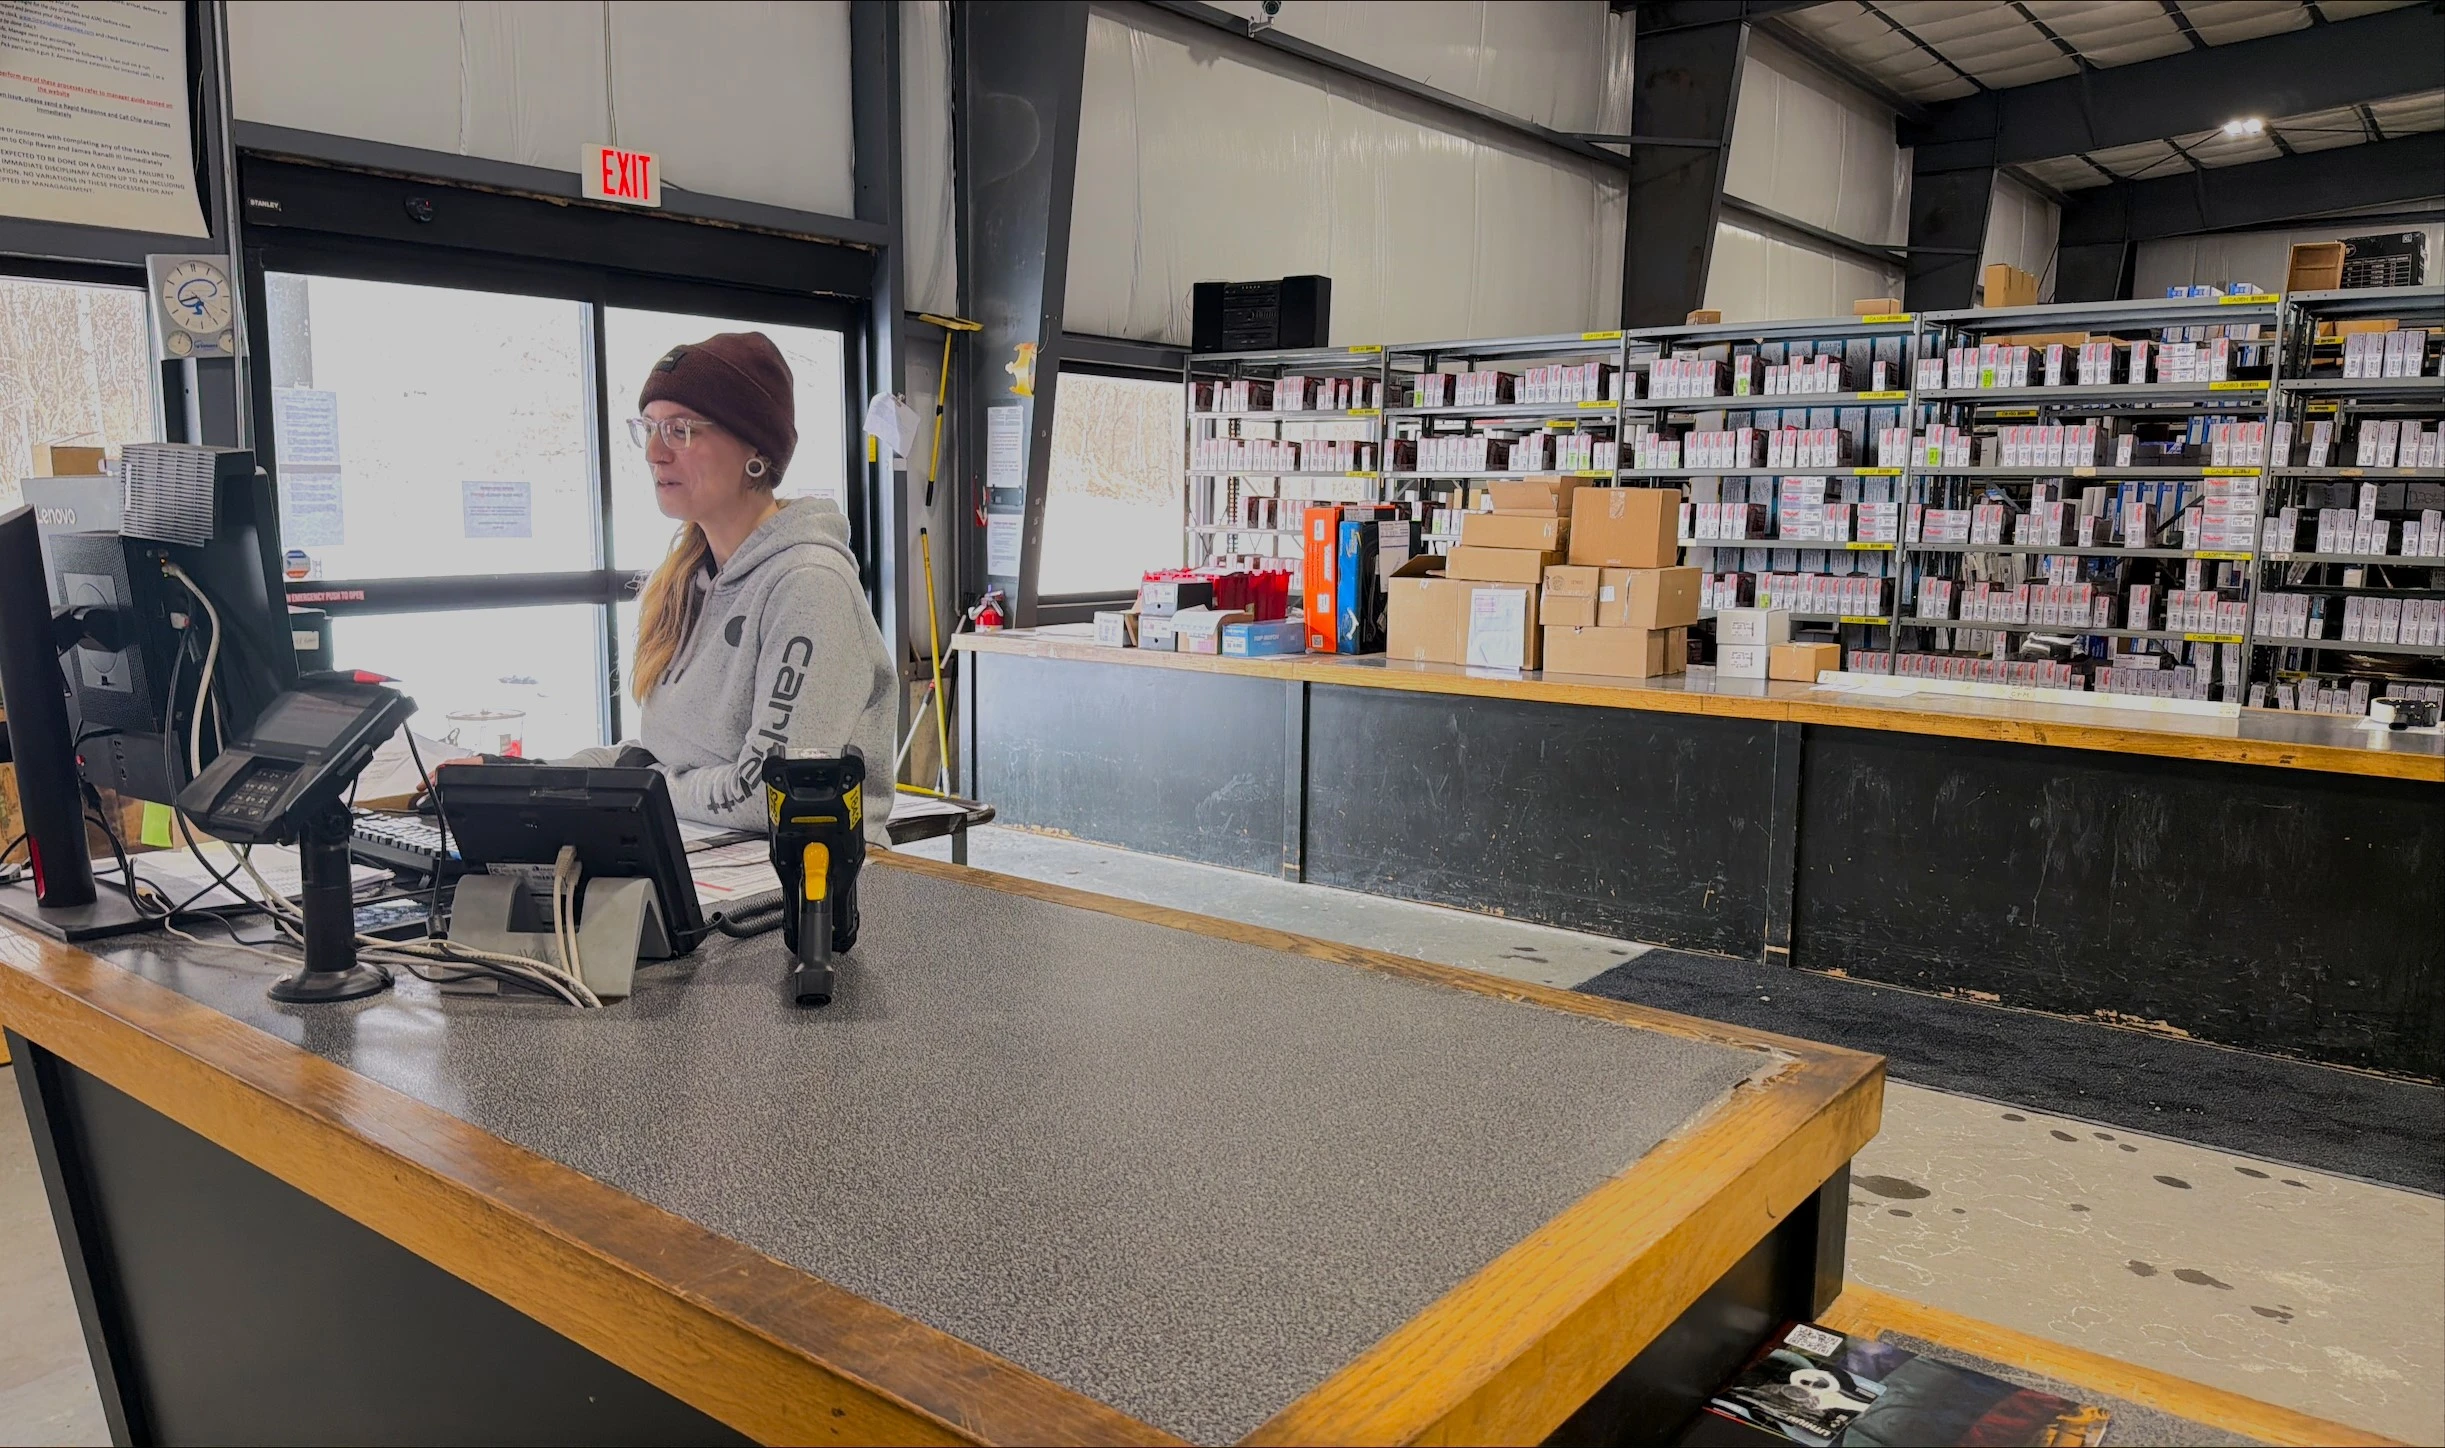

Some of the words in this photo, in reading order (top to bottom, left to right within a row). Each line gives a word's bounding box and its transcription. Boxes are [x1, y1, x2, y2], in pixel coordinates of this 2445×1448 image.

[48, 89, 70, 98] website
[57, 83, 84, 92] processes
[107, 92, 130, 101] manager
[147, 99, 165, 108] posted
[25, 97, 42, 105] please
[64, 103, 79, 112] Rapid
[154, 120, 171, 128] James
[16, 129, 45, 139] concerns
[63, 137, 99, 148] completing
[151, 151, 172, 160] above,
[72, 147, 91, 156] James
[1, 149, 34, 159] EXPECTED
[57, 157, 77, 166] DONE
[139, 170, 164, 179] FAILURE
[602, 149, 651, 200] EXIT
[35, 172, 77, 183] VARIATIONS
[109, 182, 145, 193] PROCESSES
[45, 165, 89, 176] DISCIPLINARY
[92, 171, 116, 180] ACTION
[150, 179, 185, 190] INCLUDING
[250, 199, 279, 210] STANLEY
[34, 503, 77, 525] Lenovo
[292, 592, 325, 602] EMERGENCY
[326, 591, 340, 601] PUSH
[341, 590, 348, 600] TO
[349, 590, 364, 600] OPEN
